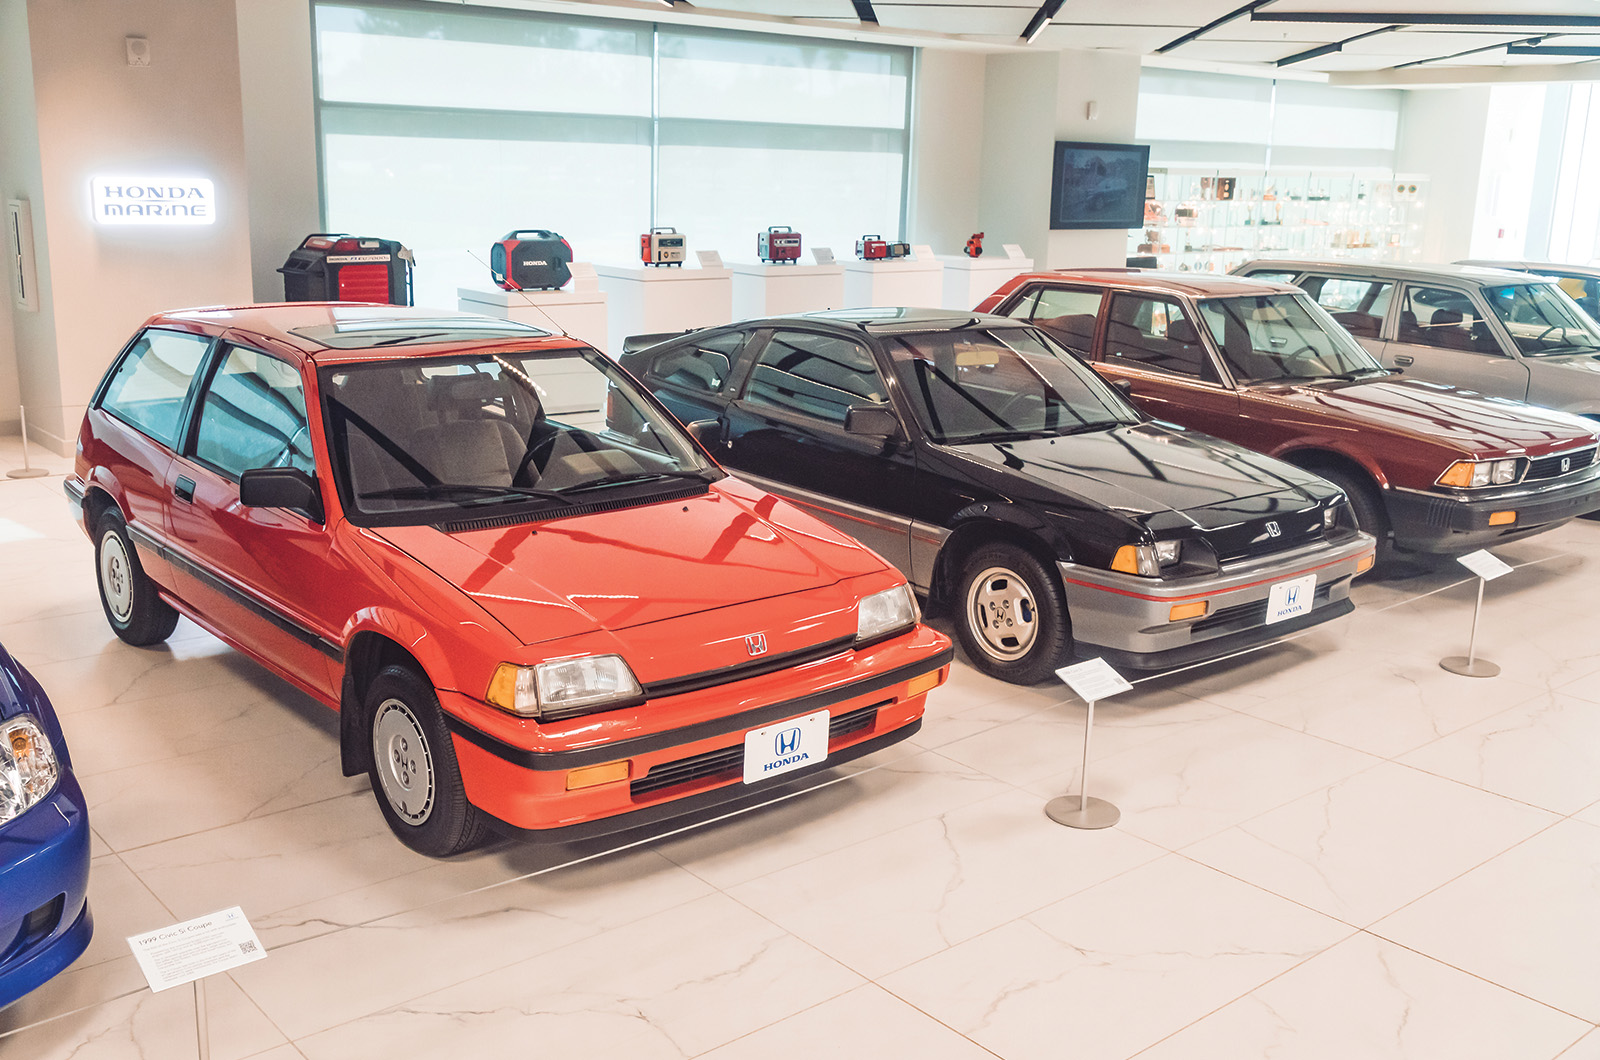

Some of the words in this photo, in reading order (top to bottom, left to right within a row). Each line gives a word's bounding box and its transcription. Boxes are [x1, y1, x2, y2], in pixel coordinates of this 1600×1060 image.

[104, 185, 205, 199] HONDA
[1277, 605, 1303, 617] HONDA
[763, 752, 810, 772] HONDA
[138, 936, 157, 946] 1999
[158, 932, 178, 940] Civic
[187, 921, 213, 932] Coupe
